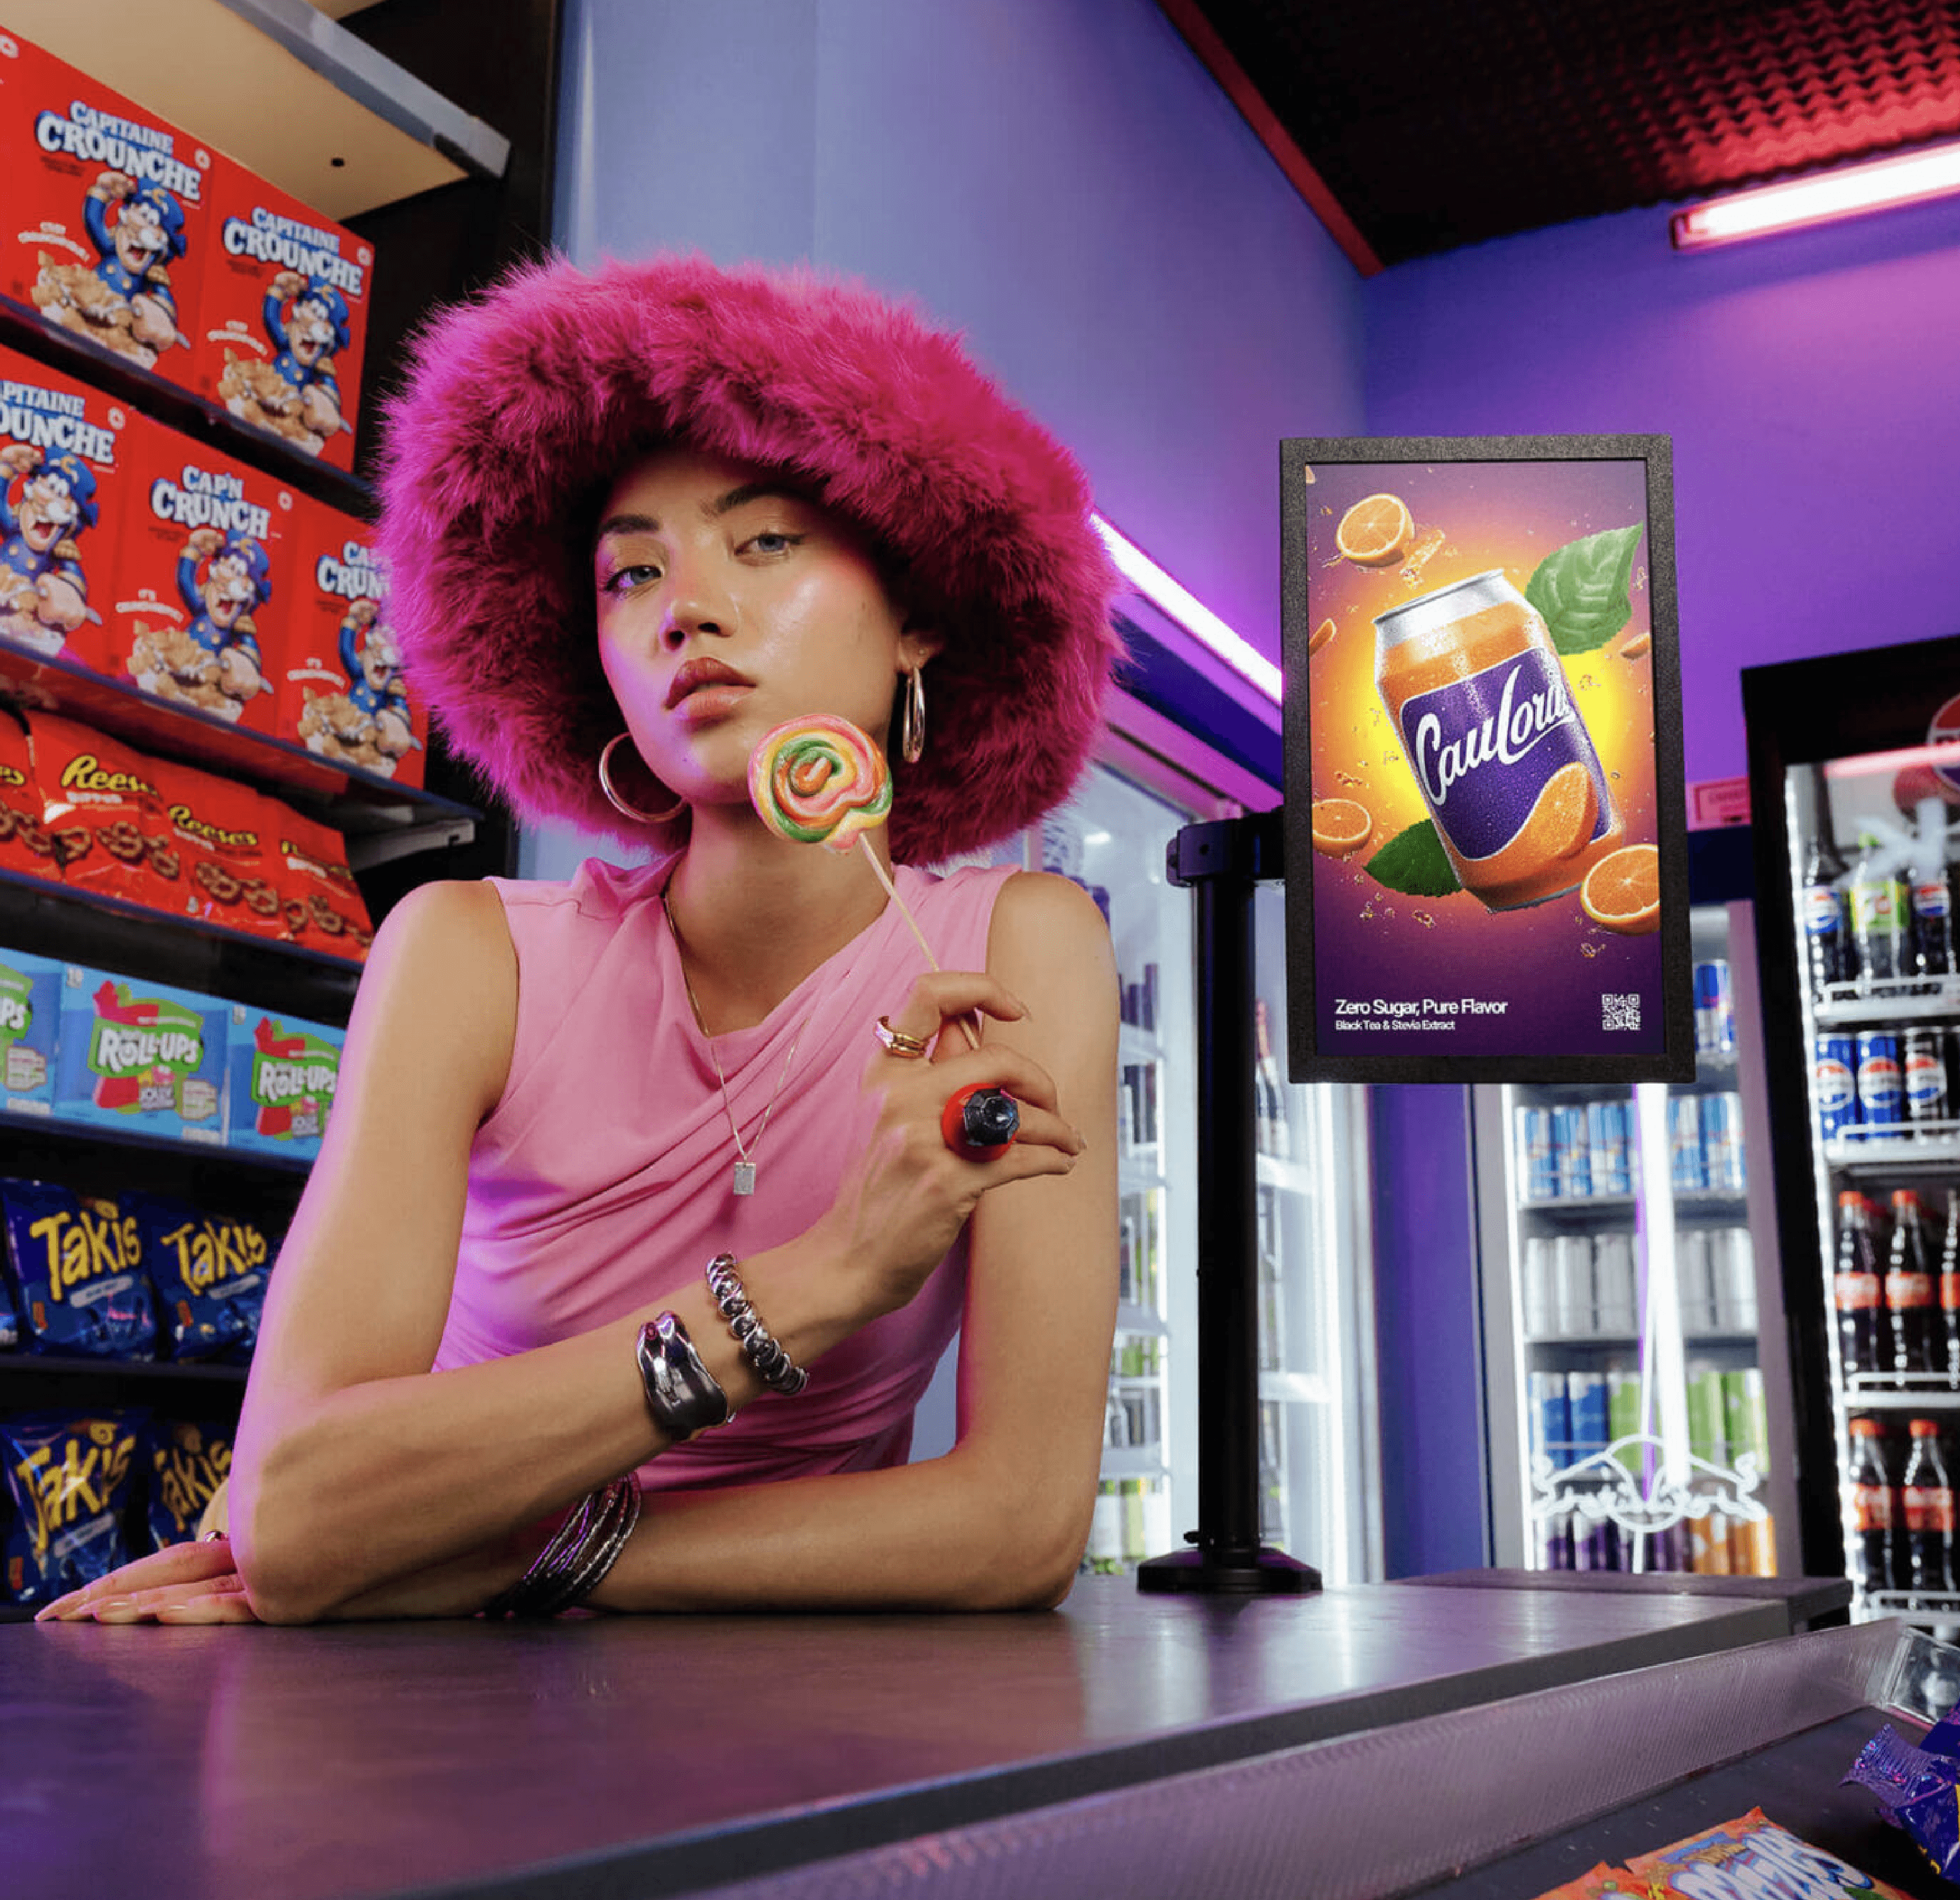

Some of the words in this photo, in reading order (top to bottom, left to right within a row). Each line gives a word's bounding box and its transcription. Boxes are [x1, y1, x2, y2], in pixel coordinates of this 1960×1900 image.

[36, 111, 201, 200] CROUNCHE
[223, 218, 363, 295] CROUNCHE
[0, 380, 85, 418] PITAINE
[0, 403, 115, 463] OUNCHE
[150, 479, 271, 540] CRUNCH
[1335, 998, 1370, 1015] Zero
[1373, 998, 1420, 1017] Sugar,
[1422, 998, 1458, 1014] Pure
[1462, 998, 1509, 1014] Flavor
[1336, 1020, 1362, 1031] Black
[1363, 1020, 1382, 1031] Tea
[1383, 1020, 1390, 1031] &
[1392, 1019, 1421, 1031] Stevia
[1422, 1020, 1456, 1031] Extract
